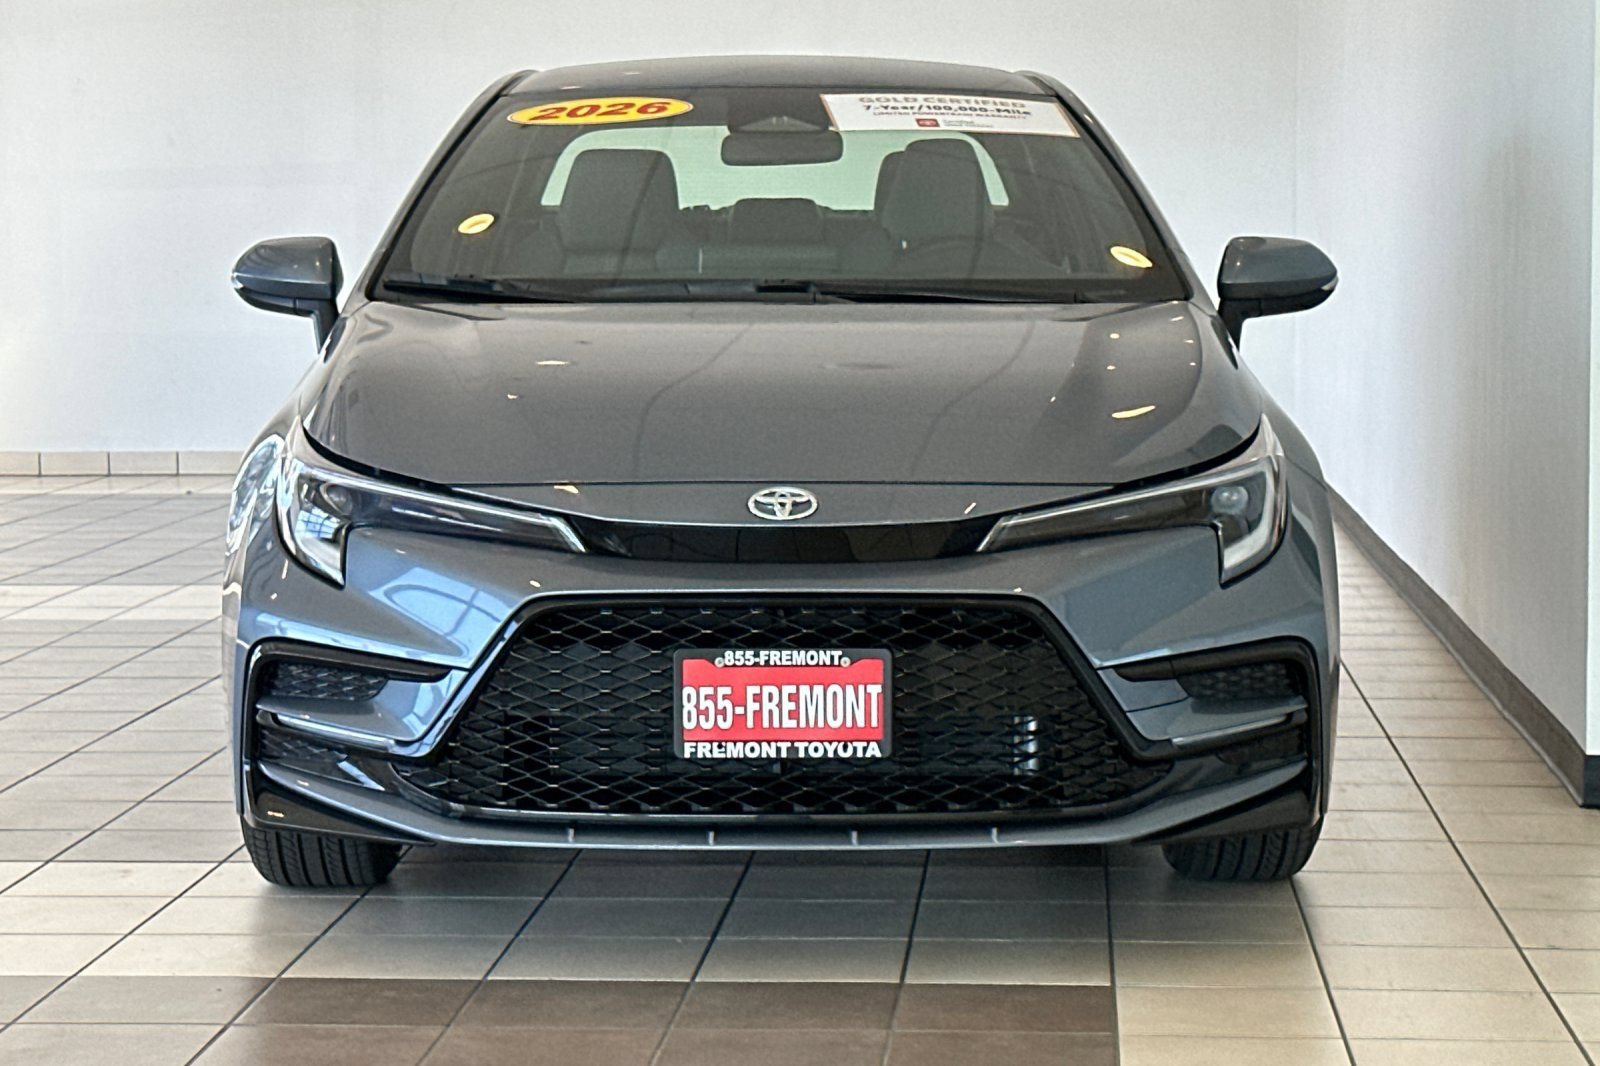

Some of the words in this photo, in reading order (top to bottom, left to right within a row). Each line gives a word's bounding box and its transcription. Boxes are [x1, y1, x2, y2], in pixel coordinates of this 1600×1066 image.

[529, 101, 671, 121] 2026
[923, 97, 1026, 108] CERTIFIED
[724, 650, 843, 666] 855-FREMONT
[681, 684, 883, 730] 855-FREMONT
[683, 741, 791, 759] FREMONT
[794, 741, 882, 758] TOYOTA
